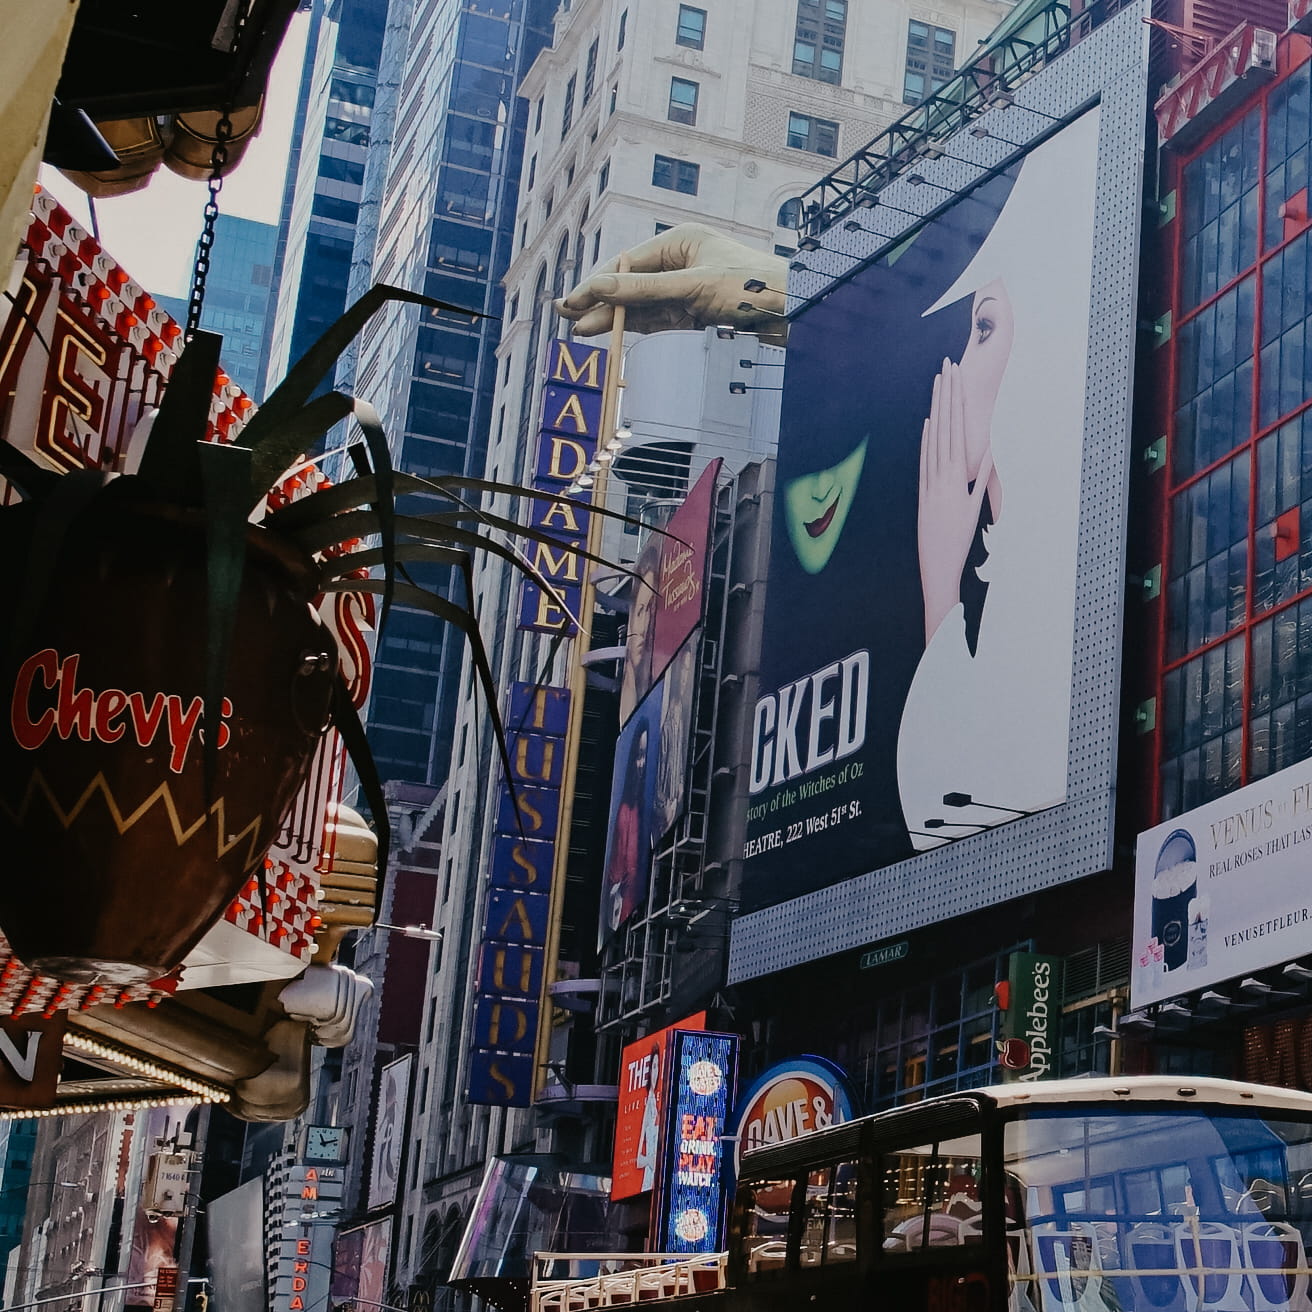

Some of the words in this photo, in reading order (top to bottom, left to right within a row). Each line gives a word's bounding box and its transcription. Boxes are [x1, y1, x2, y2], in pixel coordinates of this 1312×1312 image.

[533, 342, 600, 630] MADAME
[749, 649, 870, 795] CKED
[770, 791, 782, 812] of
[782, 788, 797, 808] the
[799, 774, 836, 800] Witches
[838, 763, 850, 784] of
[850, 761, 864, 779] Oz
[742, 829, 784, 859] HEATRE,
[786, 821, 802, 843] 222
[806, 811, 829, 835] West
[848, 799, 862, 820] St.
[1210, 799, 1273, 850] VENUS
[1209, 857, 1233, 879] REAL
[1234, 846, 1263, 869] ROSES
[1265, 832, 1292, 857] THAT
[488, 686, 549, 1101] TUSSAUDS
[865, 944, 903, 967] LAMAR
[1018, 961, 1052, 1082] Applebee's
[628, 1053, 652, 1093] THE
[747, 1097, 811, 1150] DAVE
